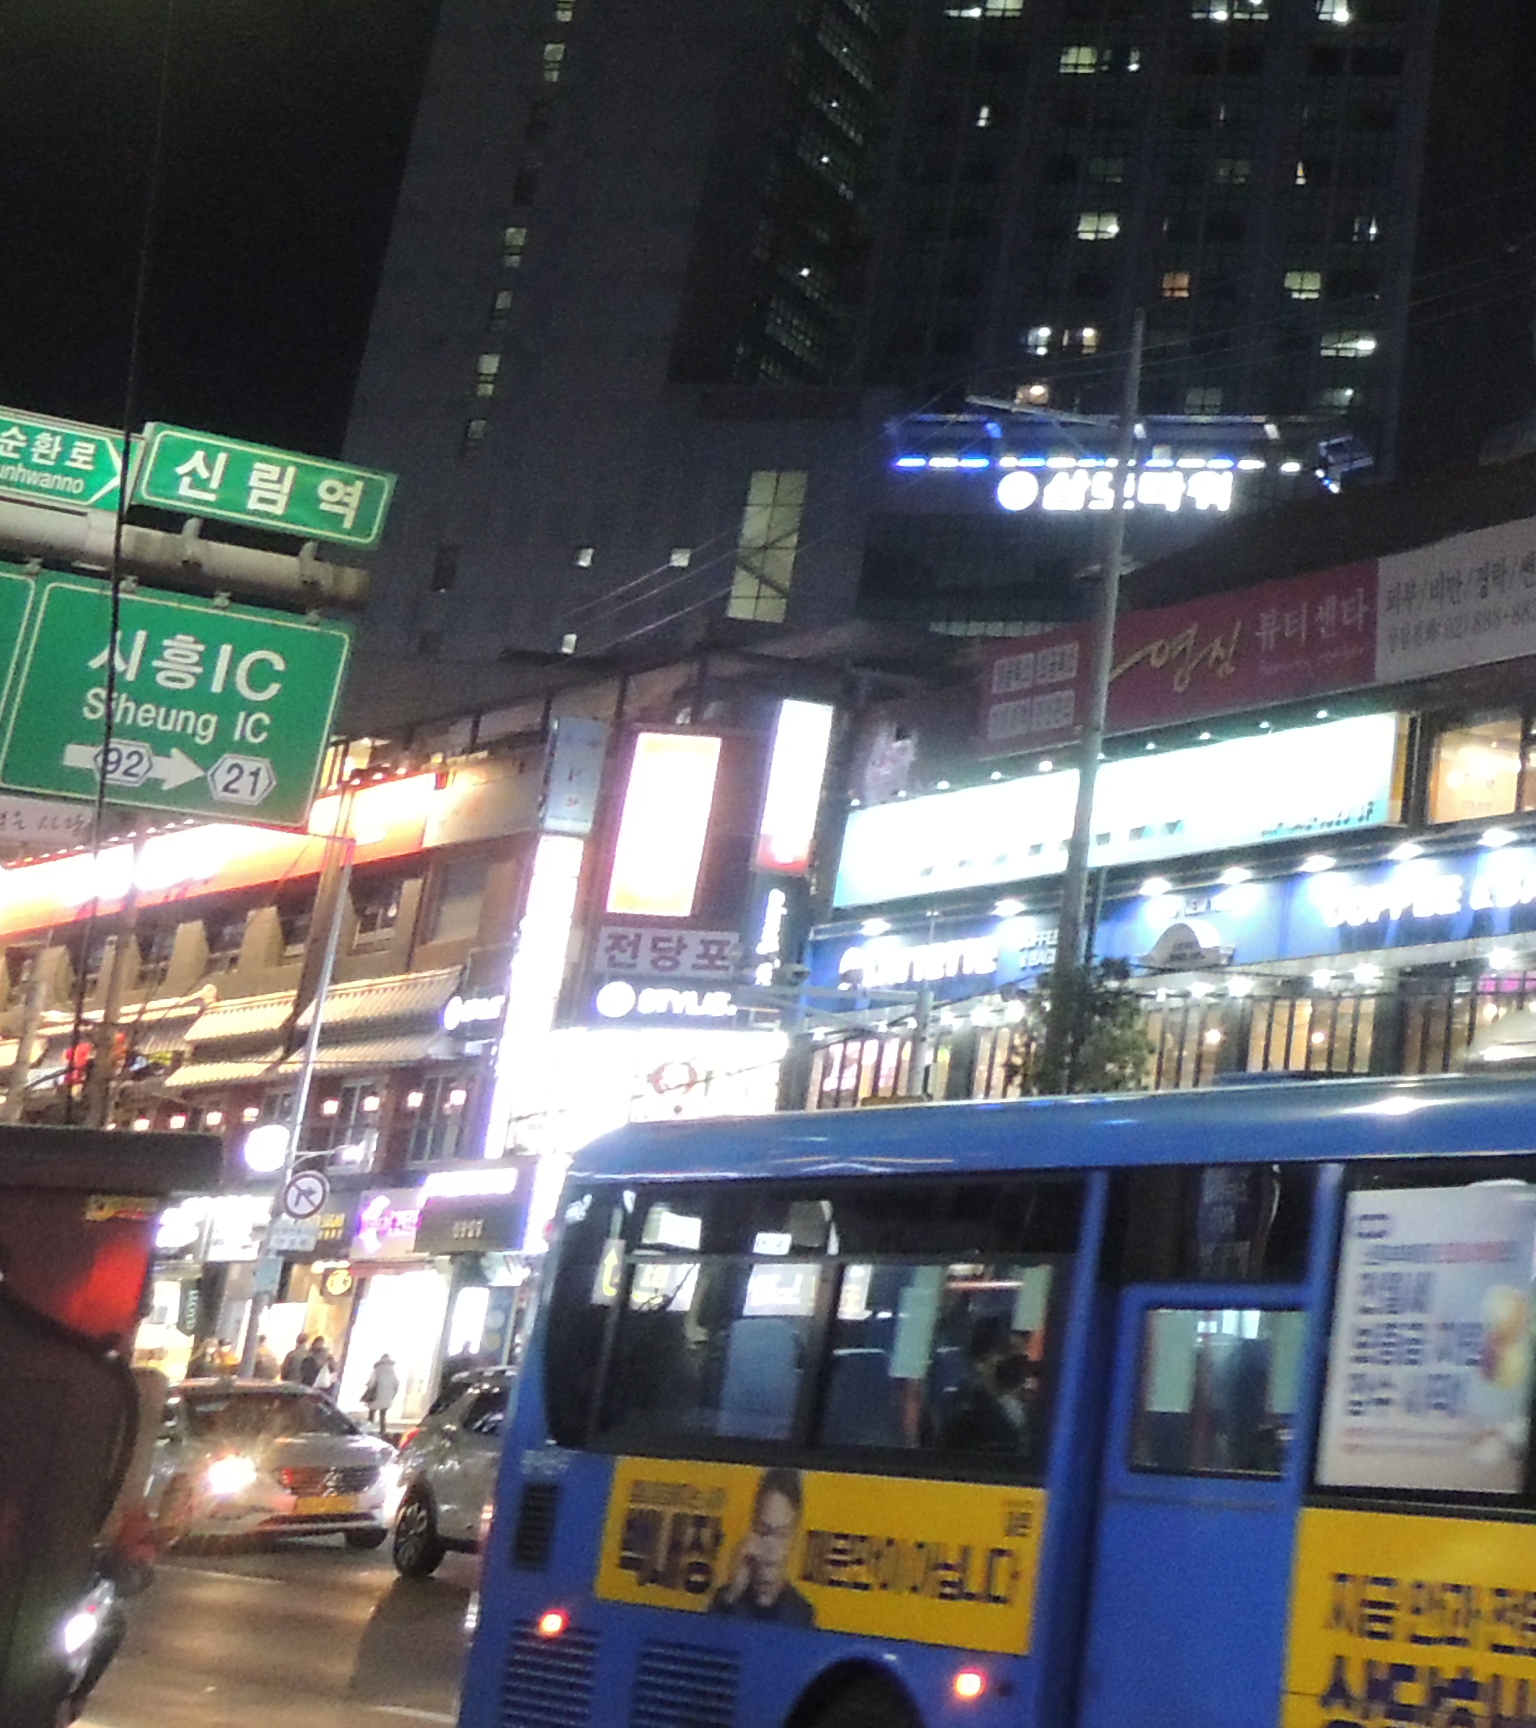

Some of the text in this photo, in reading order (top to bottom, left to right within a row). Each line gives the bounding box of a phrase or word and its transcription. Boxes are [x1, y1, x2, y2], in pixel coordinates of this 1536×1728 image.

[174, 448, 365, 530] 신림역
[88, 628, 286, 702] 시흥IC
[82, 686, 272, 744] Siheung IC
[101, 745, 145, 781] 92
[222, 761, 260, 798] 21
[604, 932, 733, 972] 전당포
